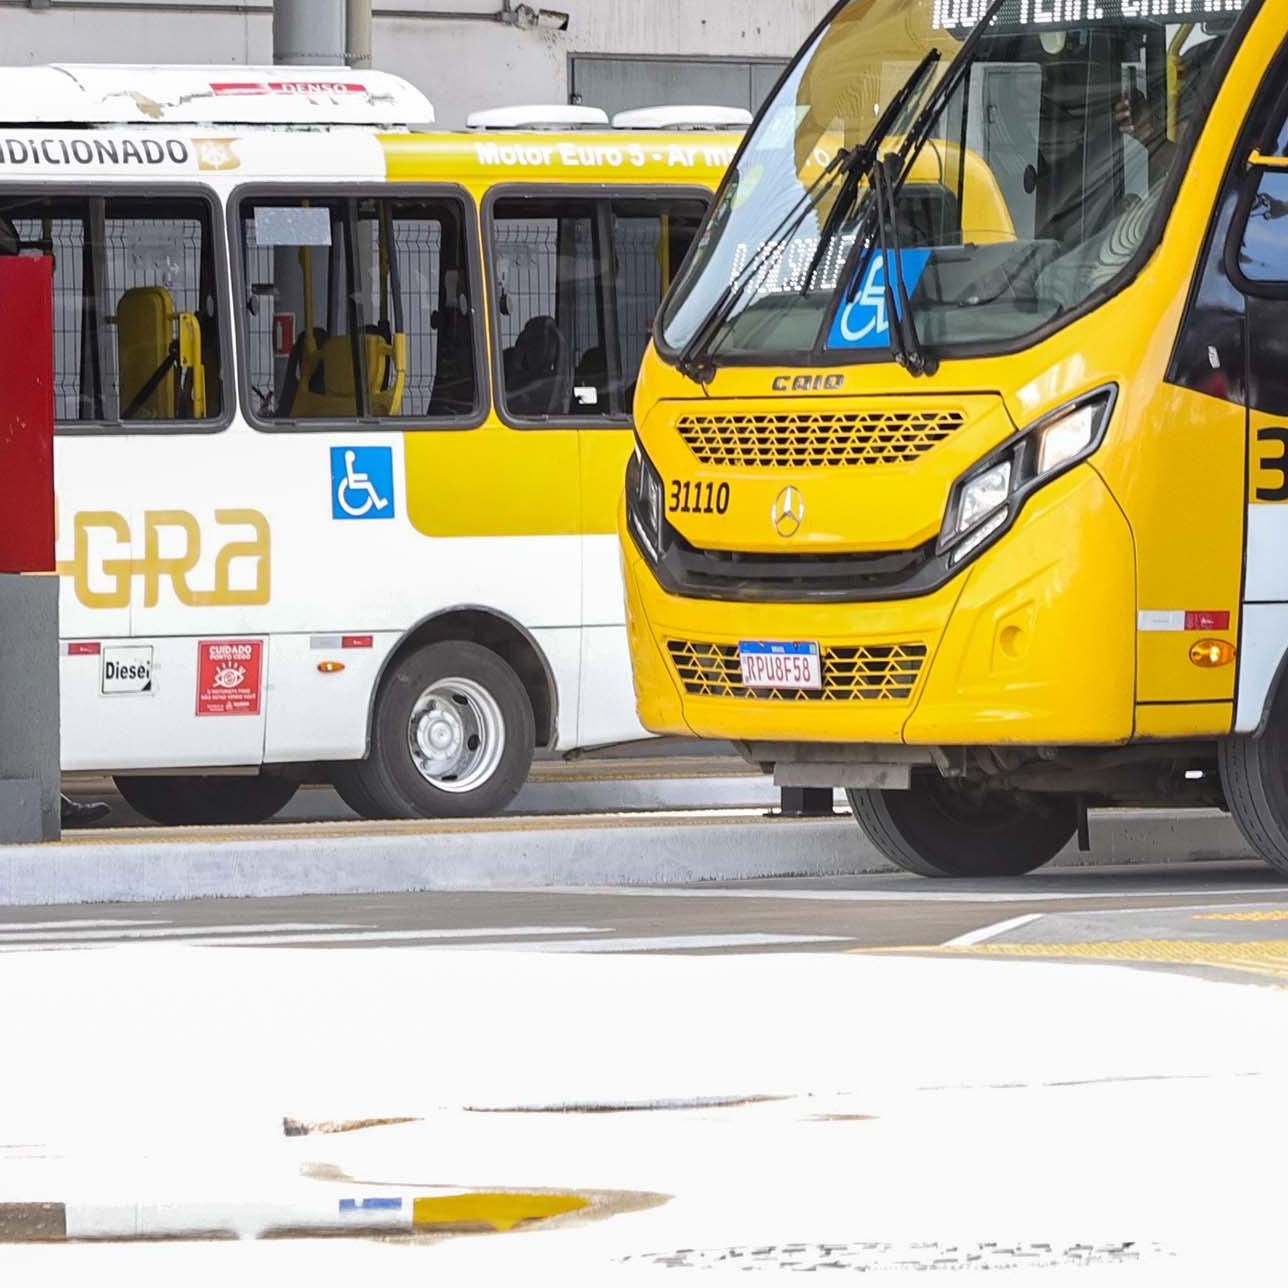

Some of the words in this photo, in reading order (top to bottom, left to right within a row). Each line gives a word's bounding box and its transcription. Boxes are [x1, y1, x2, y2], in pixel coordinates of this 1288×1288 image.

[281, 82, 347, 94] DENSO
[474, 142, 552, 167] Motor
[562, 143, 623, 167] Euro
[629, 144, 644, 167] 5
[667, 144, 701, 166] Ar
[772, 374, 845, 391] CAIO
[669, 480, 730, 514] 31110
[209, 644, 252, 655] CUIDADO
[747, 656, 811, 682] RPU8F58
